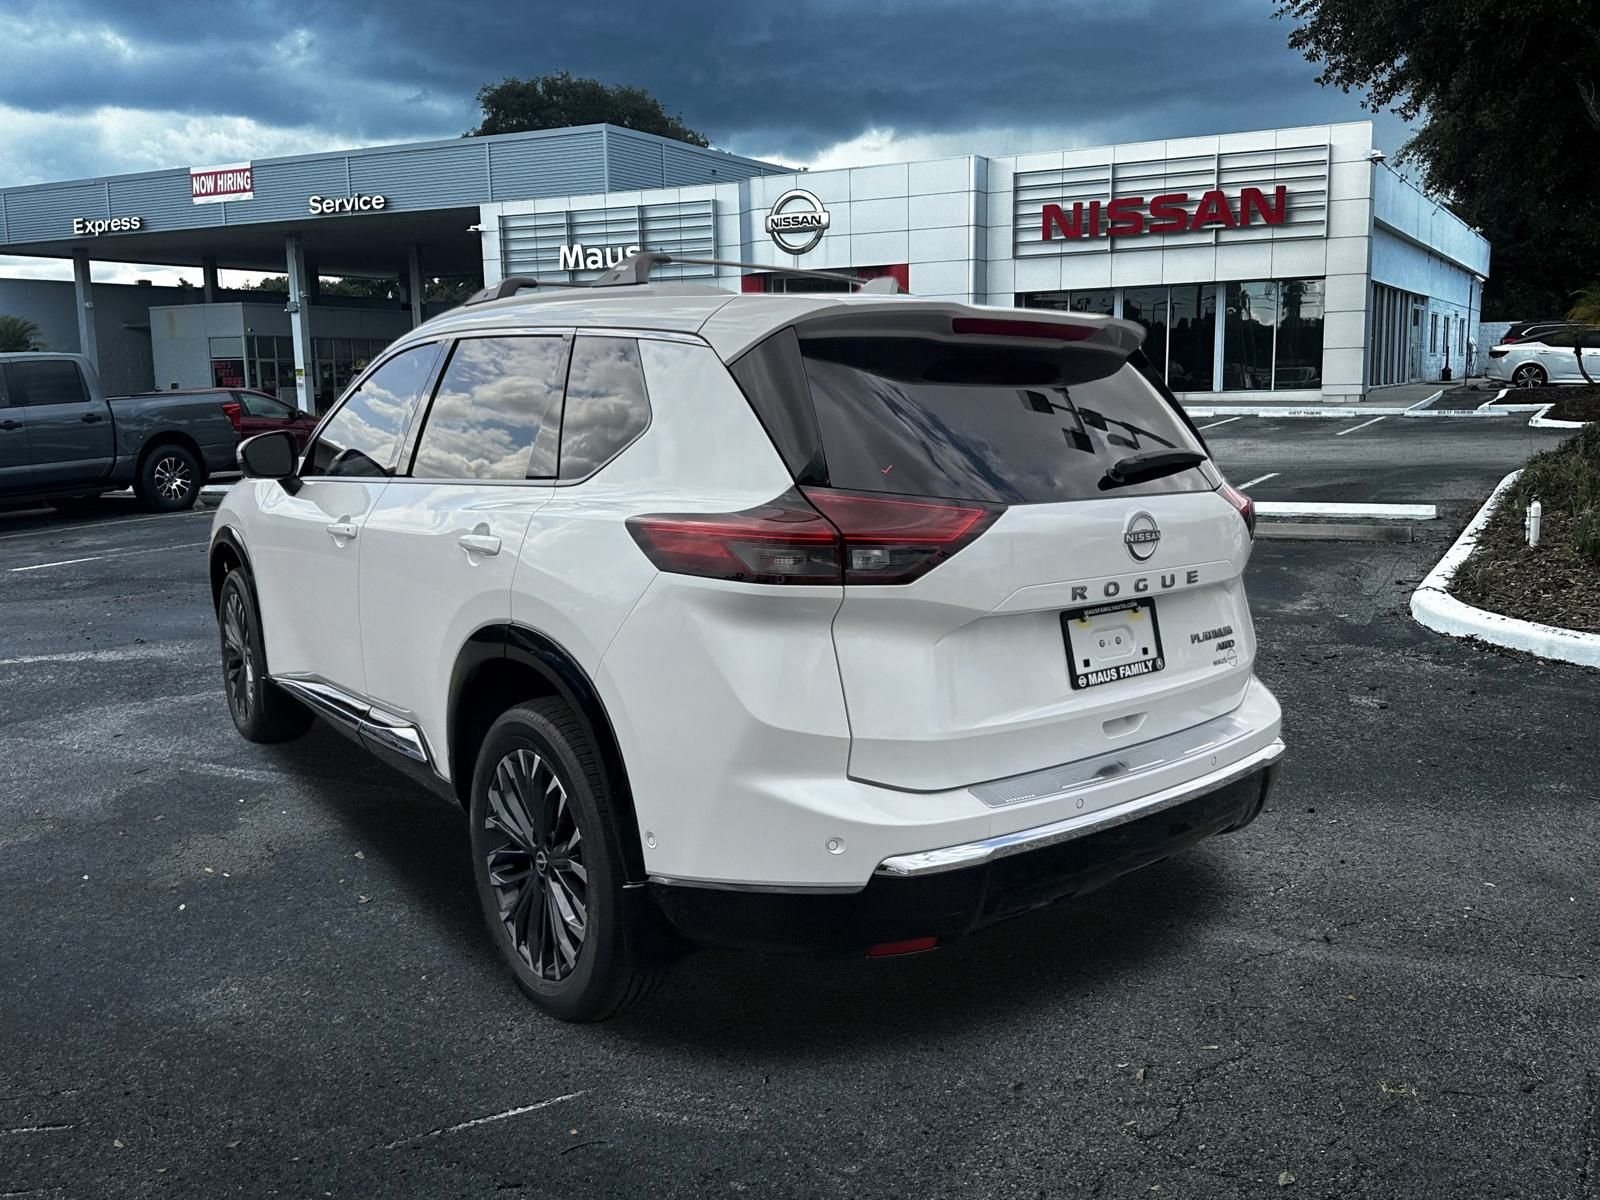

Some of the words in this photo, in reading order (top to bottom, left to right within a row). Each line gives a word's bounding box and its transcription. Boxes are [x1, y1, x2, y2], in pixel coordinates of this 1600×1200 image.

[192, 176, 215, 195] NOW
[217, 170, 251, 193] HIRING
[309, 193, 385, 214] Service
[1042, 185, 1287, 241] NISSAN
[73, 216, 141, 236] Express
[770, 215, 822, 229] NISSAN
[1126, 531, 1161, 542] NISSAN
[1071, 570, 1199, 601] ROGUE
[1088, 669, 1118, 685] MAUS
[1119, 660, 1153, 678] FAMILY
